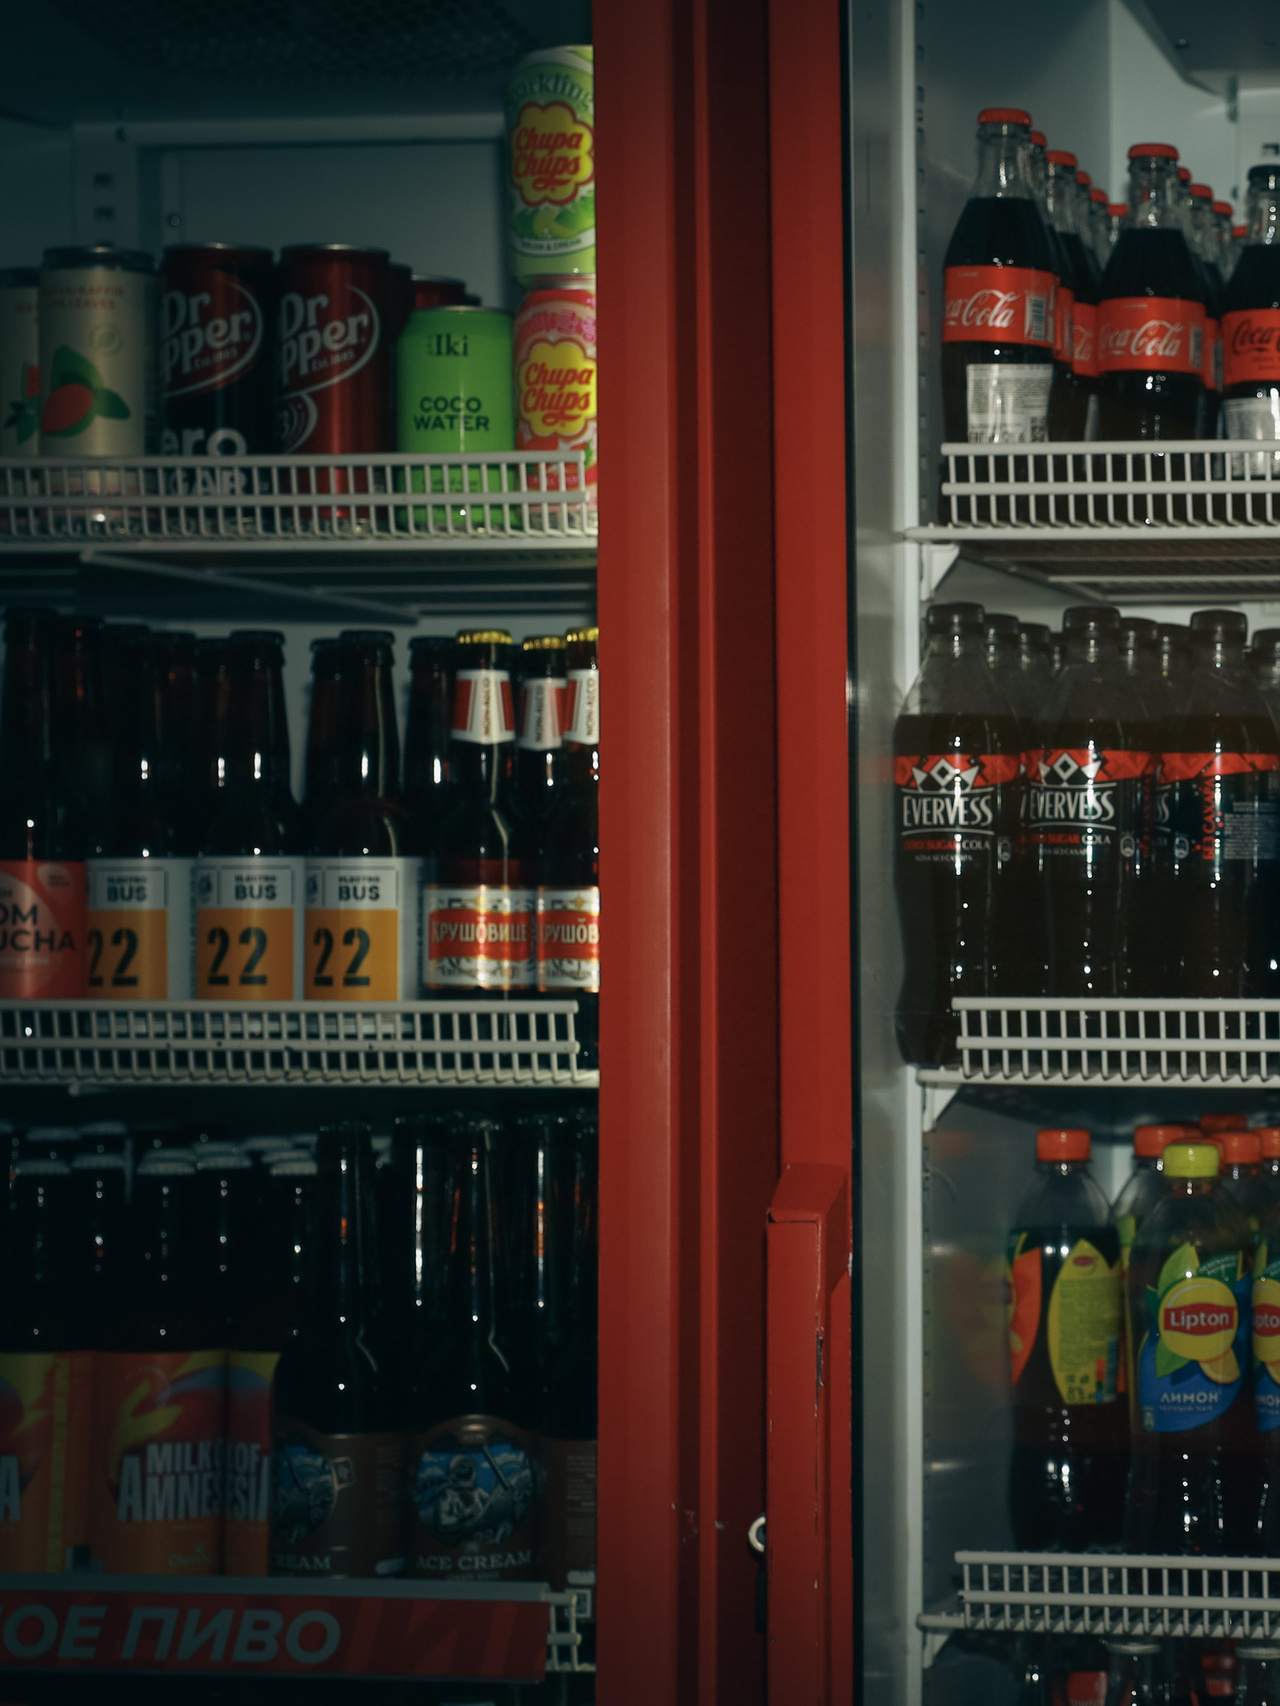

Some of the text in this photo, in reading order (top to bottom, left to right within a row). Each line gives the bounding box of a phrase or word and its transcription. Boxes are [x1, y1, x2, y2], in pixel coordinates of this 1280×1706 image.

[516, 127, 583, 153] Chupa
[514, 150, 580, 190] Chups
[163, 290, 212, 338] Dr
[281, 291, 329, 345] Dr
[163, 308, 252, 386] pper
[281, 312, 370, 387] pper
[525, 362, 593, 391] Chupa
[419, 396, 482, 413] COCO
[522, 386, 590, 426] Chups
[414, 415, 490, 433] WATER
[161, 427, 248, 455] ero
[167, 468, 248, 496] GAR
[902, 795, 994, 827] EVERVESS
[1029, 789, 1116, 822] EVERVESS
[962, 839, 991, 851] COLA
[1081, 833, 1111, 845] COLA
[107, 886, 146, 902] BUS
[234, 885, 277, 900] BUS
[338, 885, 380, 900] BUS
[87, 927, 138, 987] 22
[207, 926, 268, 986] 22
[313, 926, 371, 987] 22
[1169, 1311, 1230, 1331] Lipton
[1159, 1392, 1219, 1404] ЛИМОН
[147, 1442, 211, 1474] MILK
[274, 1554, 331, 1571] REAM
[457, 1547, 532, 1571] CREAM
[2, 1603, 342, 1665] ОЕ ПИВО
